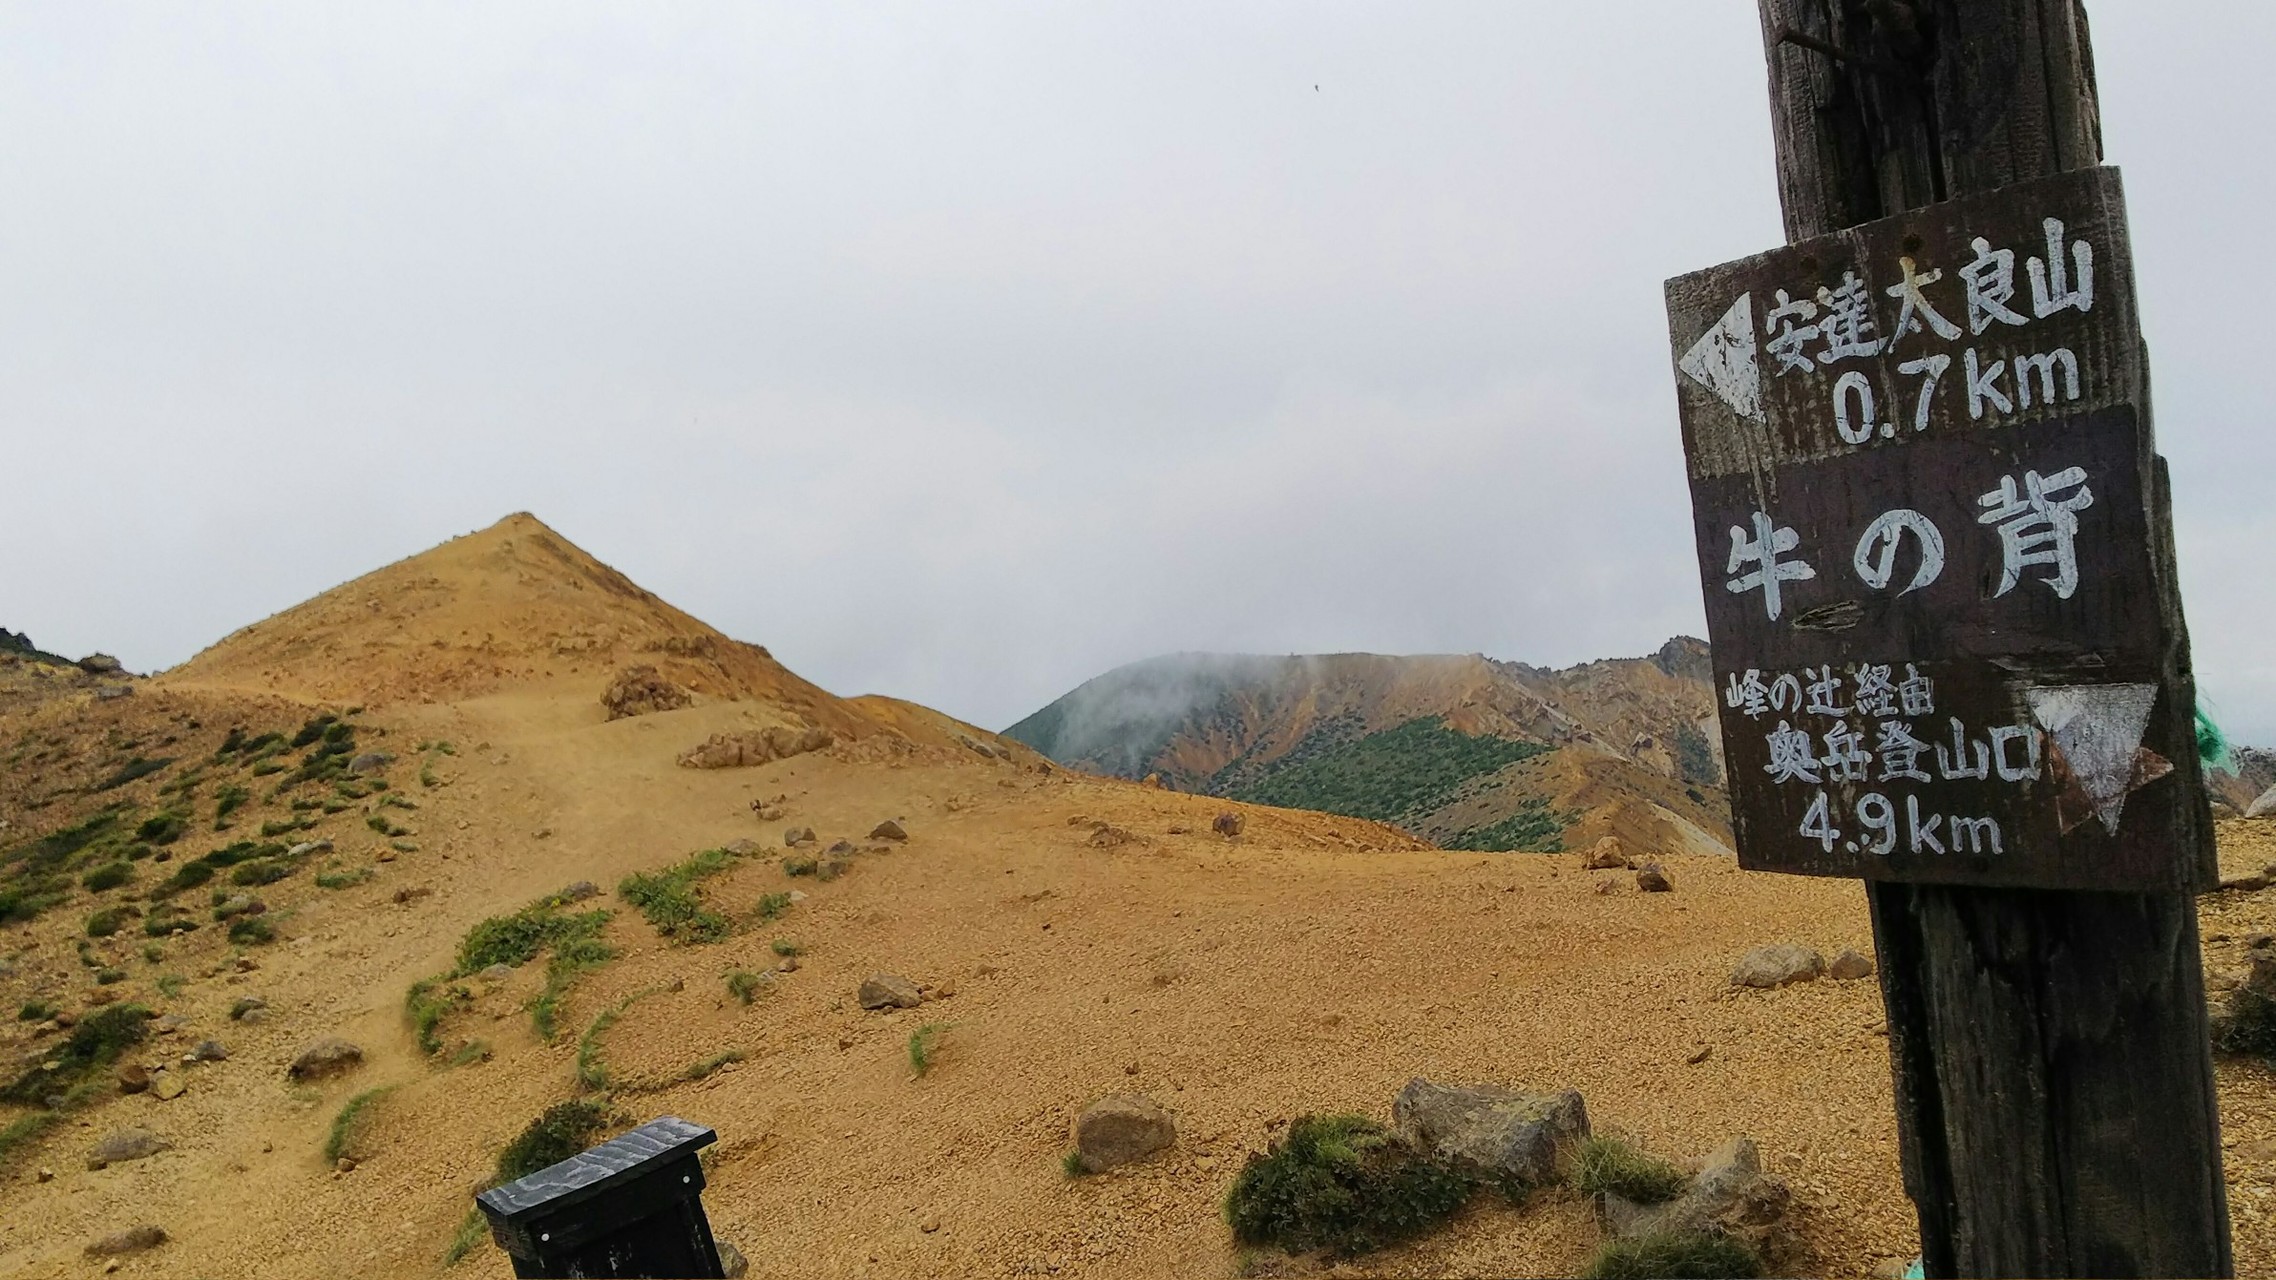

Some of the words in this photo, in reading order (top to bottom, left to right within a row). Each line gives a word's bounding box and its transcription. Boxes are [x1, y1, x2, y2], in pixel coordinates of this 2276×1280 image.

[1766, 217, 2093, 376] 安達太良山
[1726, 466, 2094, 621] 牛の背
[1726, 662, 1935, 721] 峰の辻経由
[1764, 717, 2041, 784] 奥岳登山口
